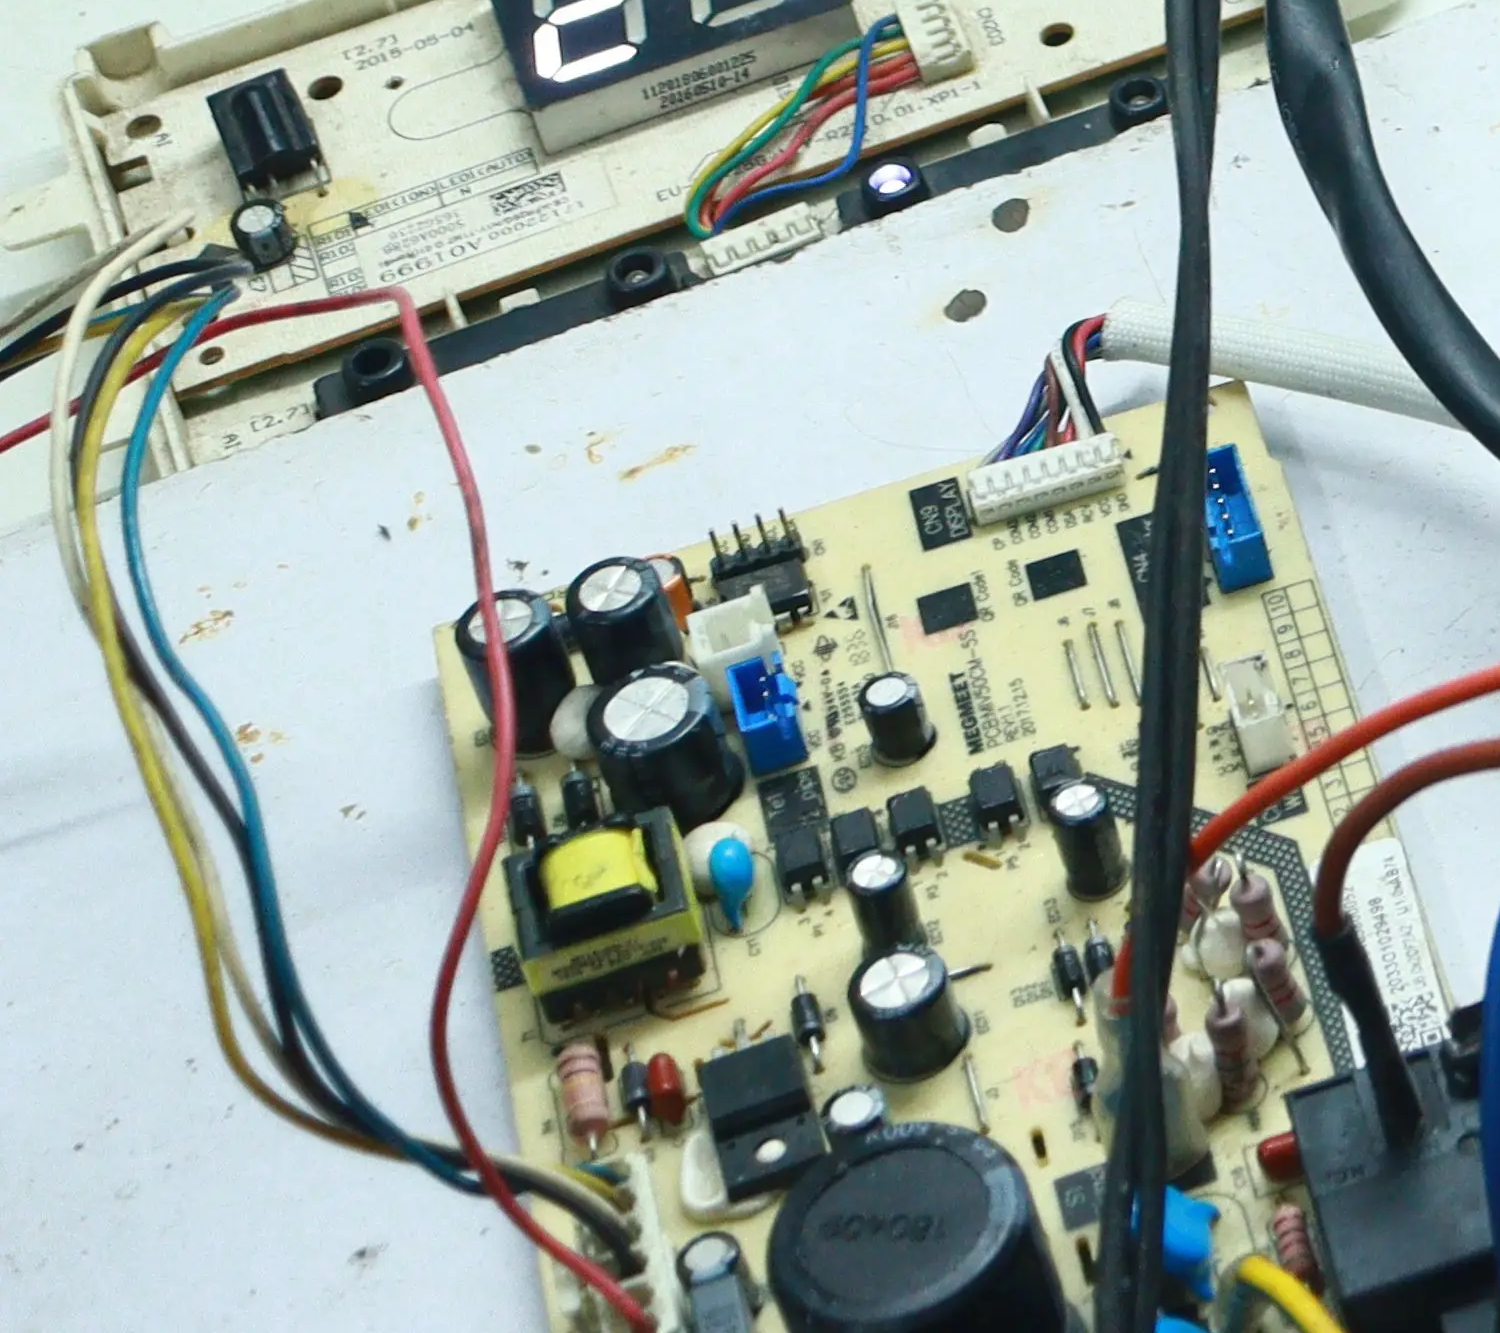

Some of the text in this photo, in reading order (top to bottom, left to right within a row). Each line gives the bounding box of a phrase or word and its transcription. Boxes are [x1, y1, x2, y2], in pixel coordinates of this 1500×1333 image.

[919, 504, 943, 536] CN9
[937, 479, 969, 541] DISPLAY
[948, 672, 986, 757] MEGMEET
